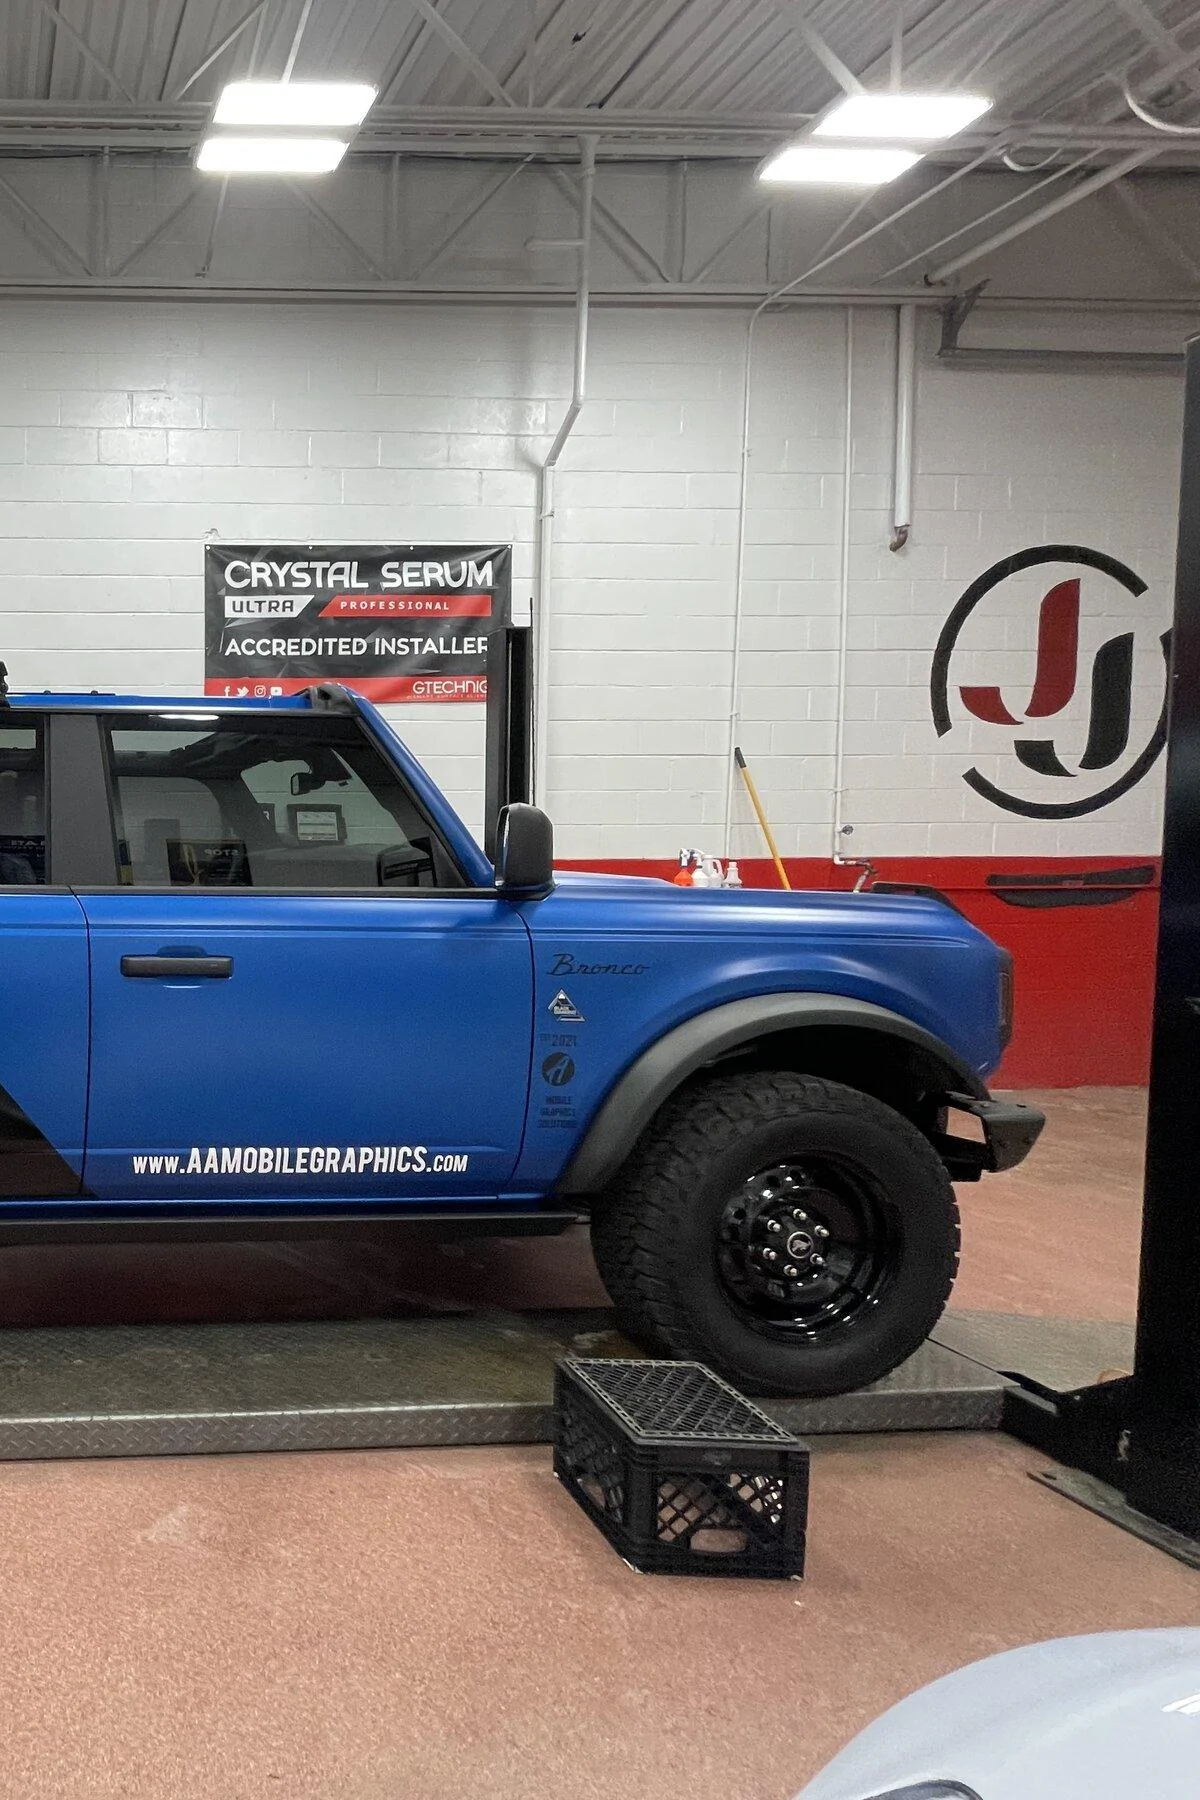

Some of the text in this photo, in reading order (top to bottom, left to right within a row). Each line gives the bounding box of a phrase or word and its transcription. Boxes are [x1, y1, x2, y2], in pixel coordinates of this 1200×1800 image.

[224, 560, 493, 588] CRYSTAL SERUM
[232, 600, 294, 613] ULTRA
[340, 601, 450, 611] PROFESSIONAL
[225, 637, 368, 656] ACCREDITED
[547, 953, 652, 976] Bronco
